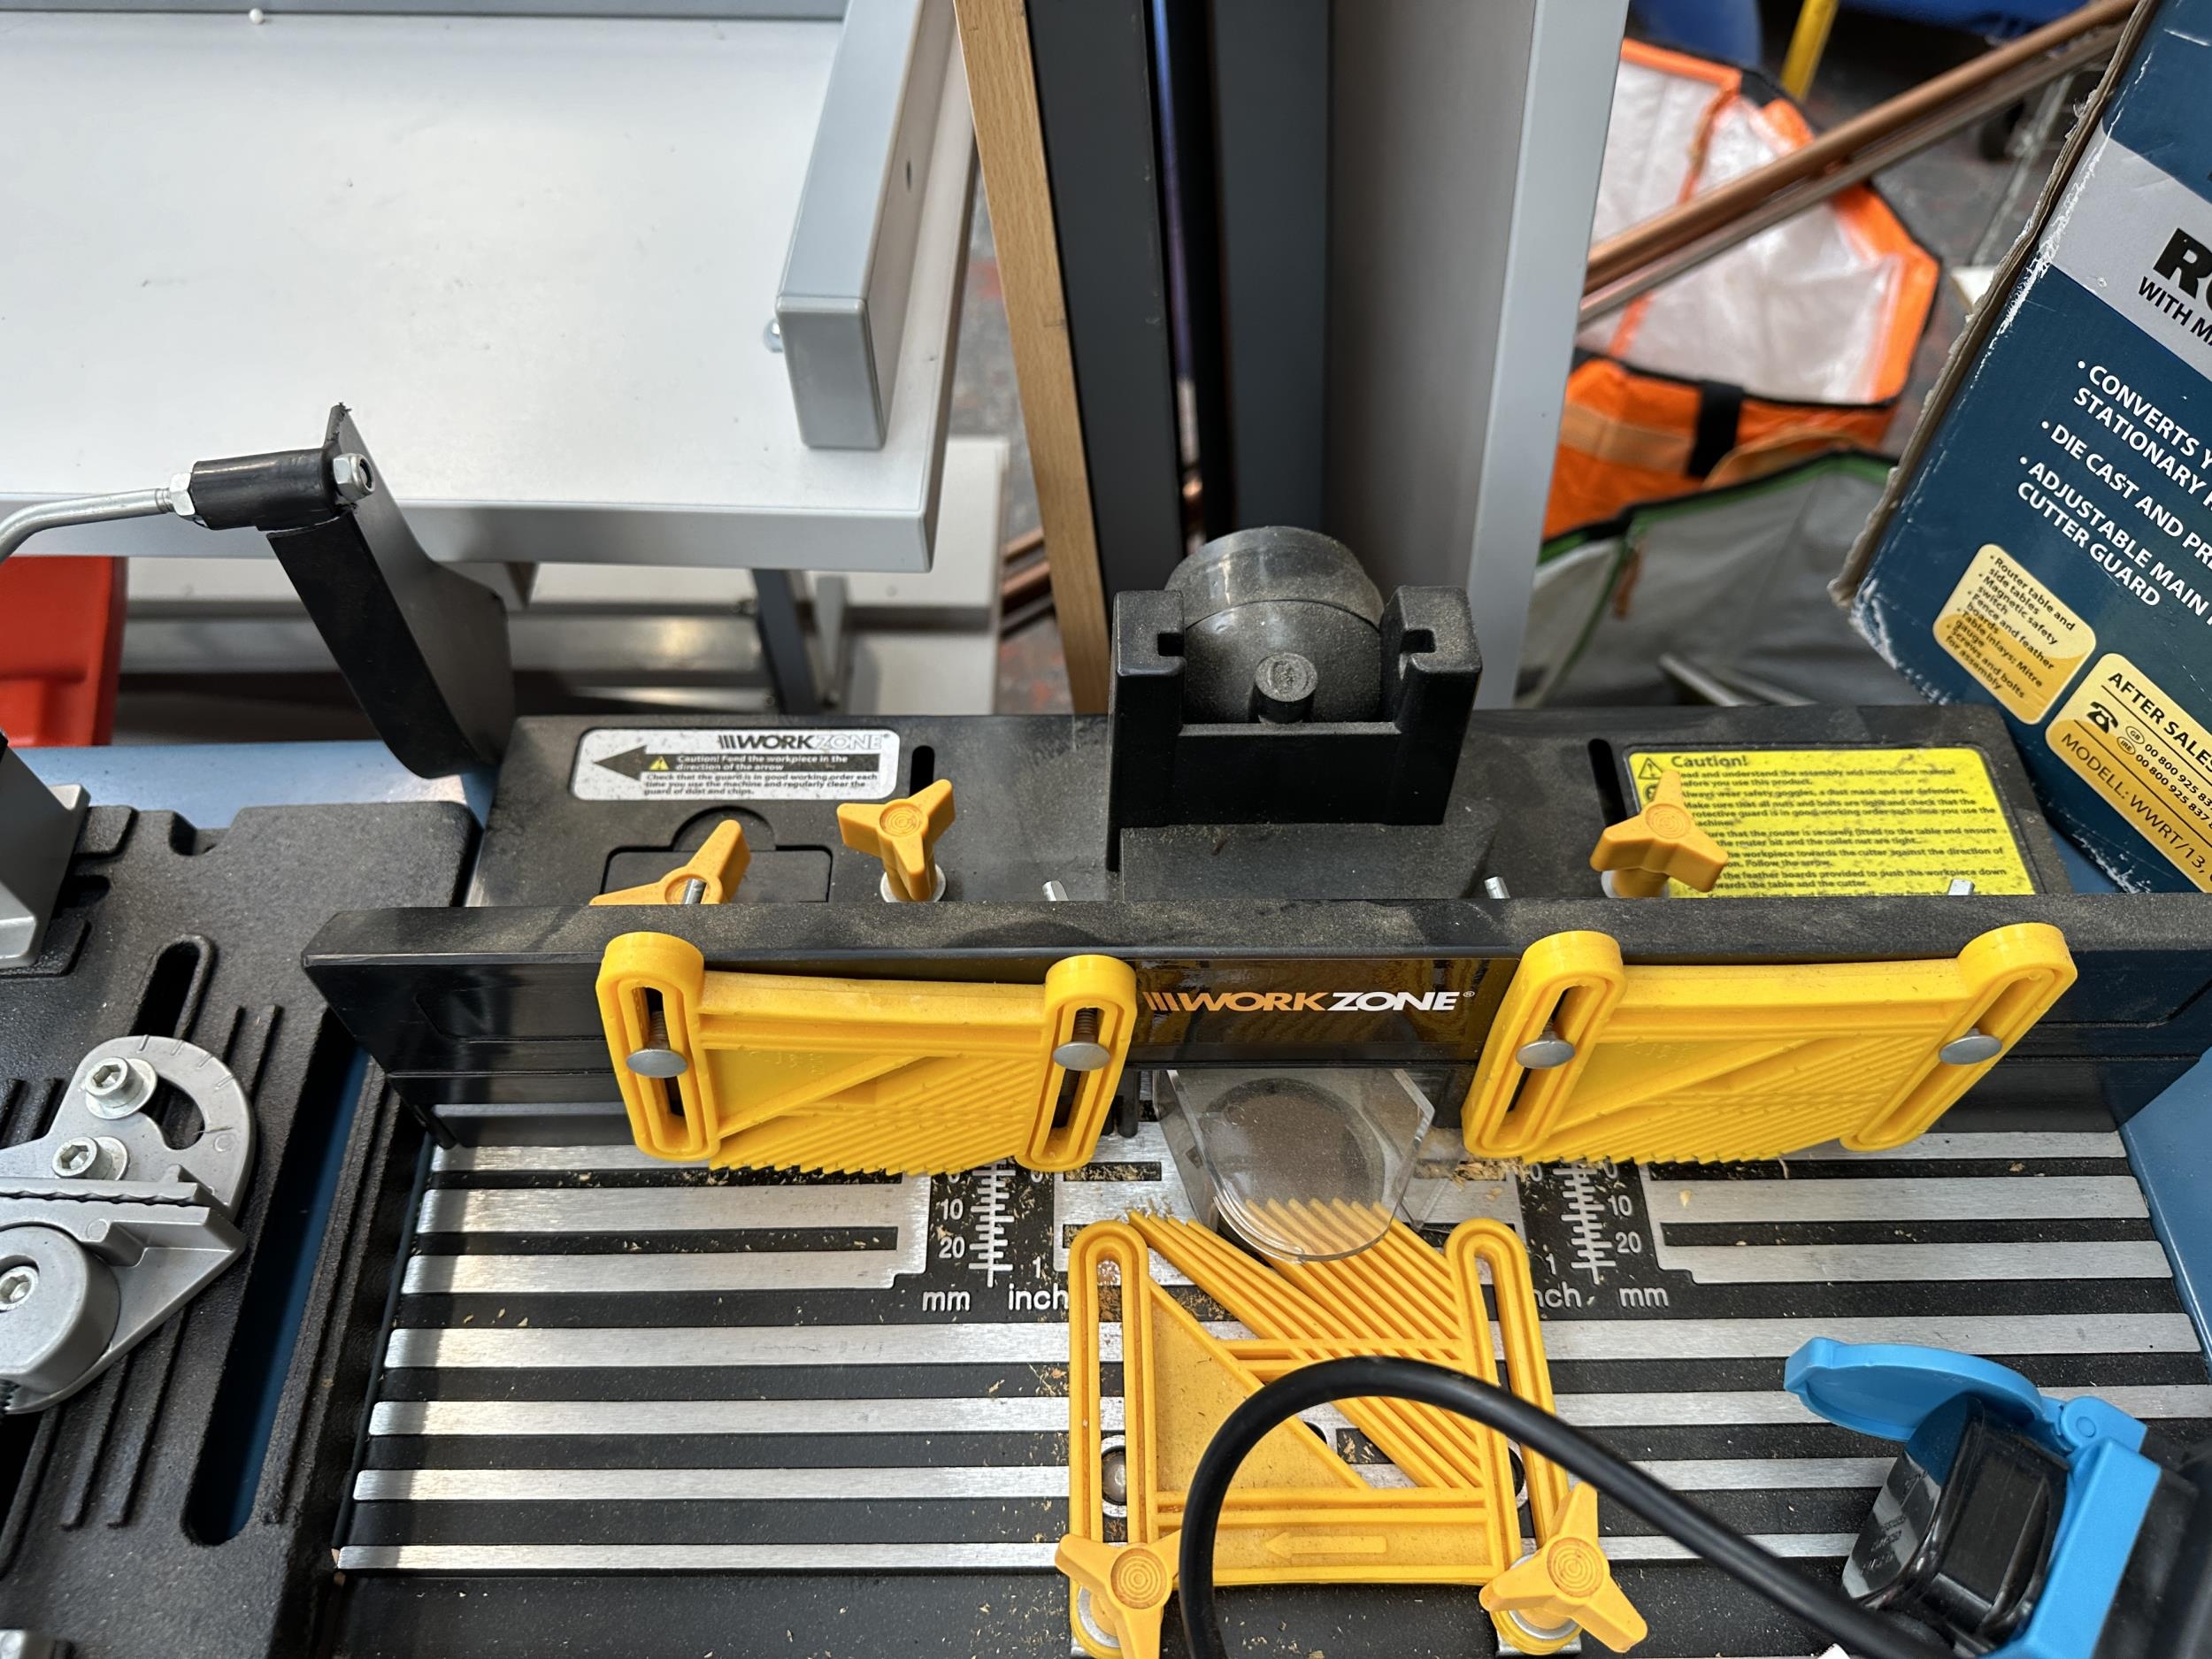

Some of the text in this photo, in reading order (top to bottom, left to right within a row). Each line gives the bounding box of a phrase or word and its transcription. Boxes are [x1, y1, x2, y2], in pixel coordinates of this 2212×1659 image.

[2153, 227, 2212, 311] R
[2138, 276, 2212, 346] WITH M
[2089, 365, 2200, 457] CONVERTS
[2073, 388, 2207, 495] STATIONARY
[2051, 424, 2087, 460] DIE
[2085, 453, 2139, 499] CAST
[2134, 495, 2184, 537] AND
[2018, 482, 2161, 606] CUTTER GUARD
[2028, 462, 2209, 616] ADJUSTABLE MAIN
[1978, 586, 2008, 616] switch
[1983, 576, 2058, 646] Magnetic safety
[1989, 568, 2039, 615] side tables
[1994, 557, 2076, 632] Router table and
[1955, 620, 1985, 649] gauge
[1967, 603, 2000, 634] boards
[1972, 594, 2055, 670] Fence and feather
[1947, 635, 2002, 690] for assembly
[1952, 627, 2025, 698] Screws and bolts
[1962, 611, 1985, 635] Table
[2016, 661, 2043, 687] Mitre
[2108, 672, 2165, 726] AFTER
[736, 734, 882, 750] WORKZONE
[766, 755, 817, 764] workpiece
[1671, 756, 1748, 768] Caution!
[2135, 754, 2209, 821] 00 800 925 837
[2145, 743, 2212, 810] 00 800 925 83
[2061, 733, 2206, 873] MODELL: WWRT/13,
[1179, 991, 1460, 1011] WORKZONE
[941, 1198, 964, 1221] 10
[1608, 1195, 1632, 1217] 10
[939, 1236, 965, 1258] 20
[1546, 1253, 1556, 1276] 1
[1615, 1231, 1641, 1254] 20
[1033, 1256, 1041, 1279] 1
[922, 1291, 971, 1311] mm
[1009, 1283, 1069, 1311] inch
[1533, 1281, 1582, 1308] nch
[1619, 1287, 1669, 1308] mm
